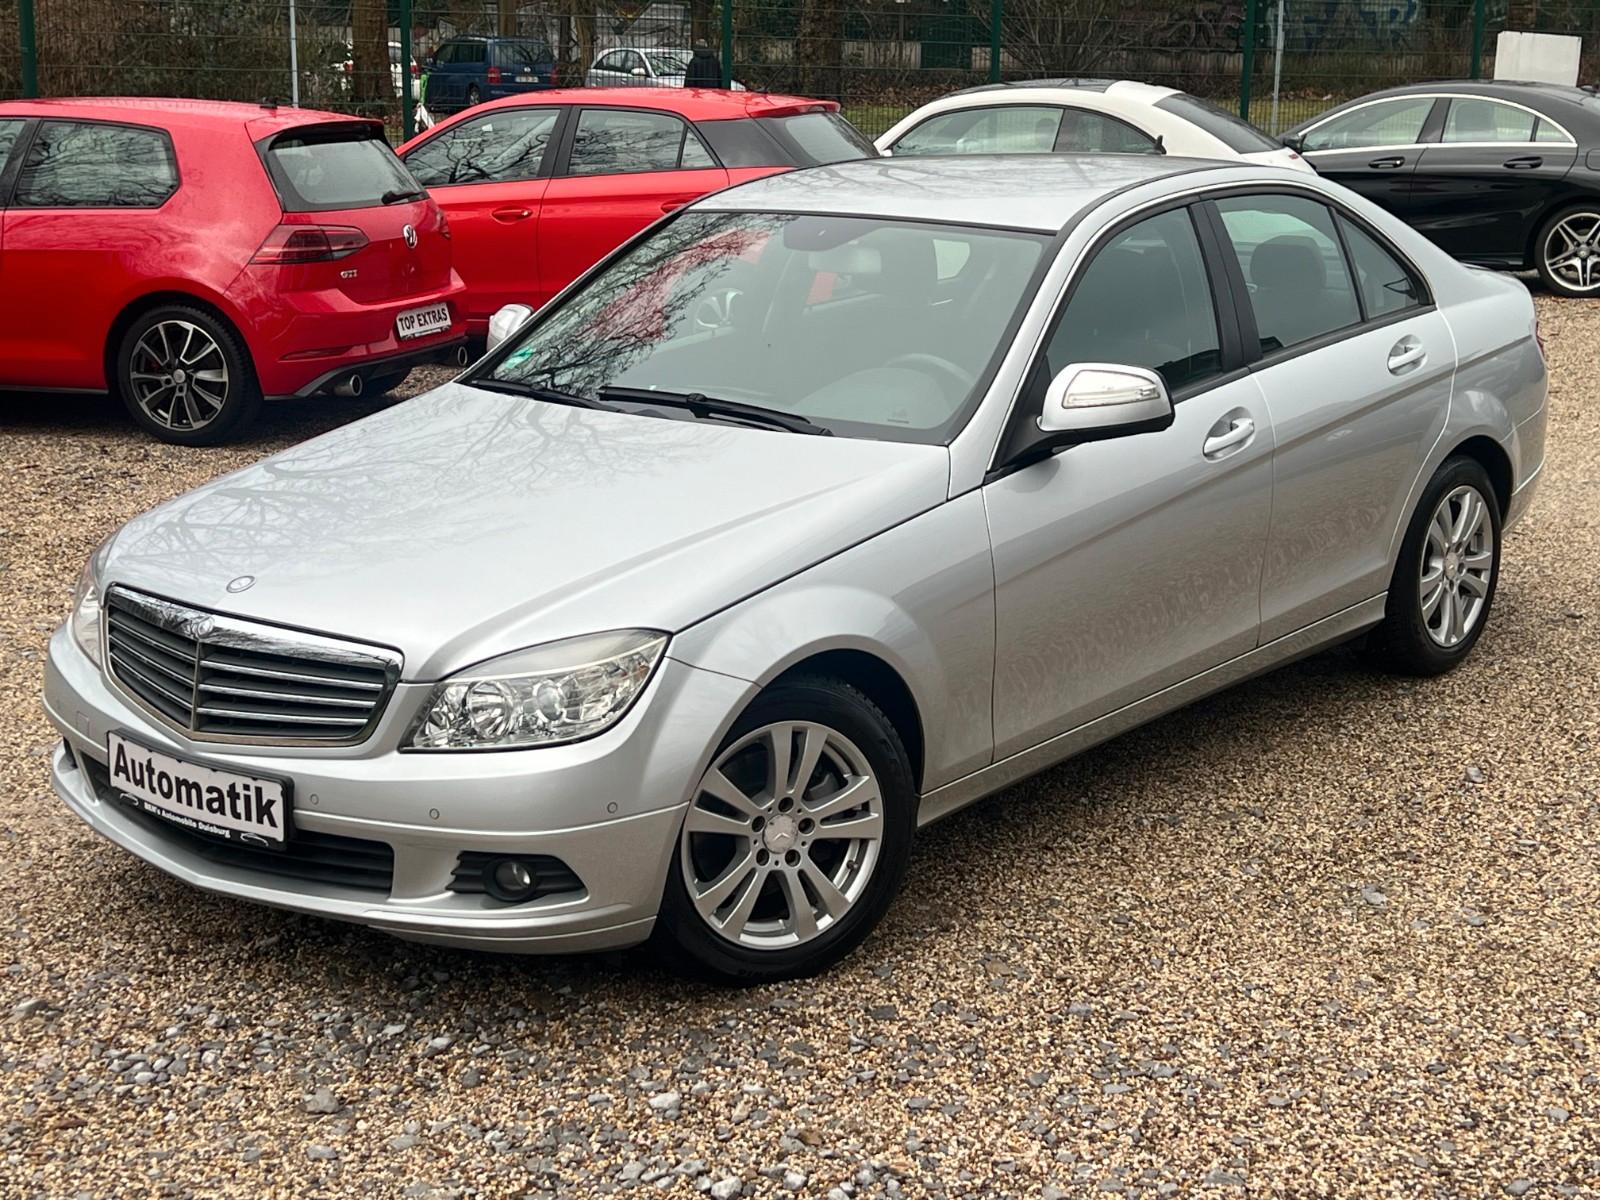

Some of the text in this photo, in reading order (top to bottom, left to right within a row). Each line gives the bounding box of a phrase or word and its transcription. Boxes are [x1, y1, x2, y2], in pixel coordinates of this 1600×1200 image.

[398, 308, 448, 331] TOP EXTRAS
[113, 743, 278, 828] Automatik
